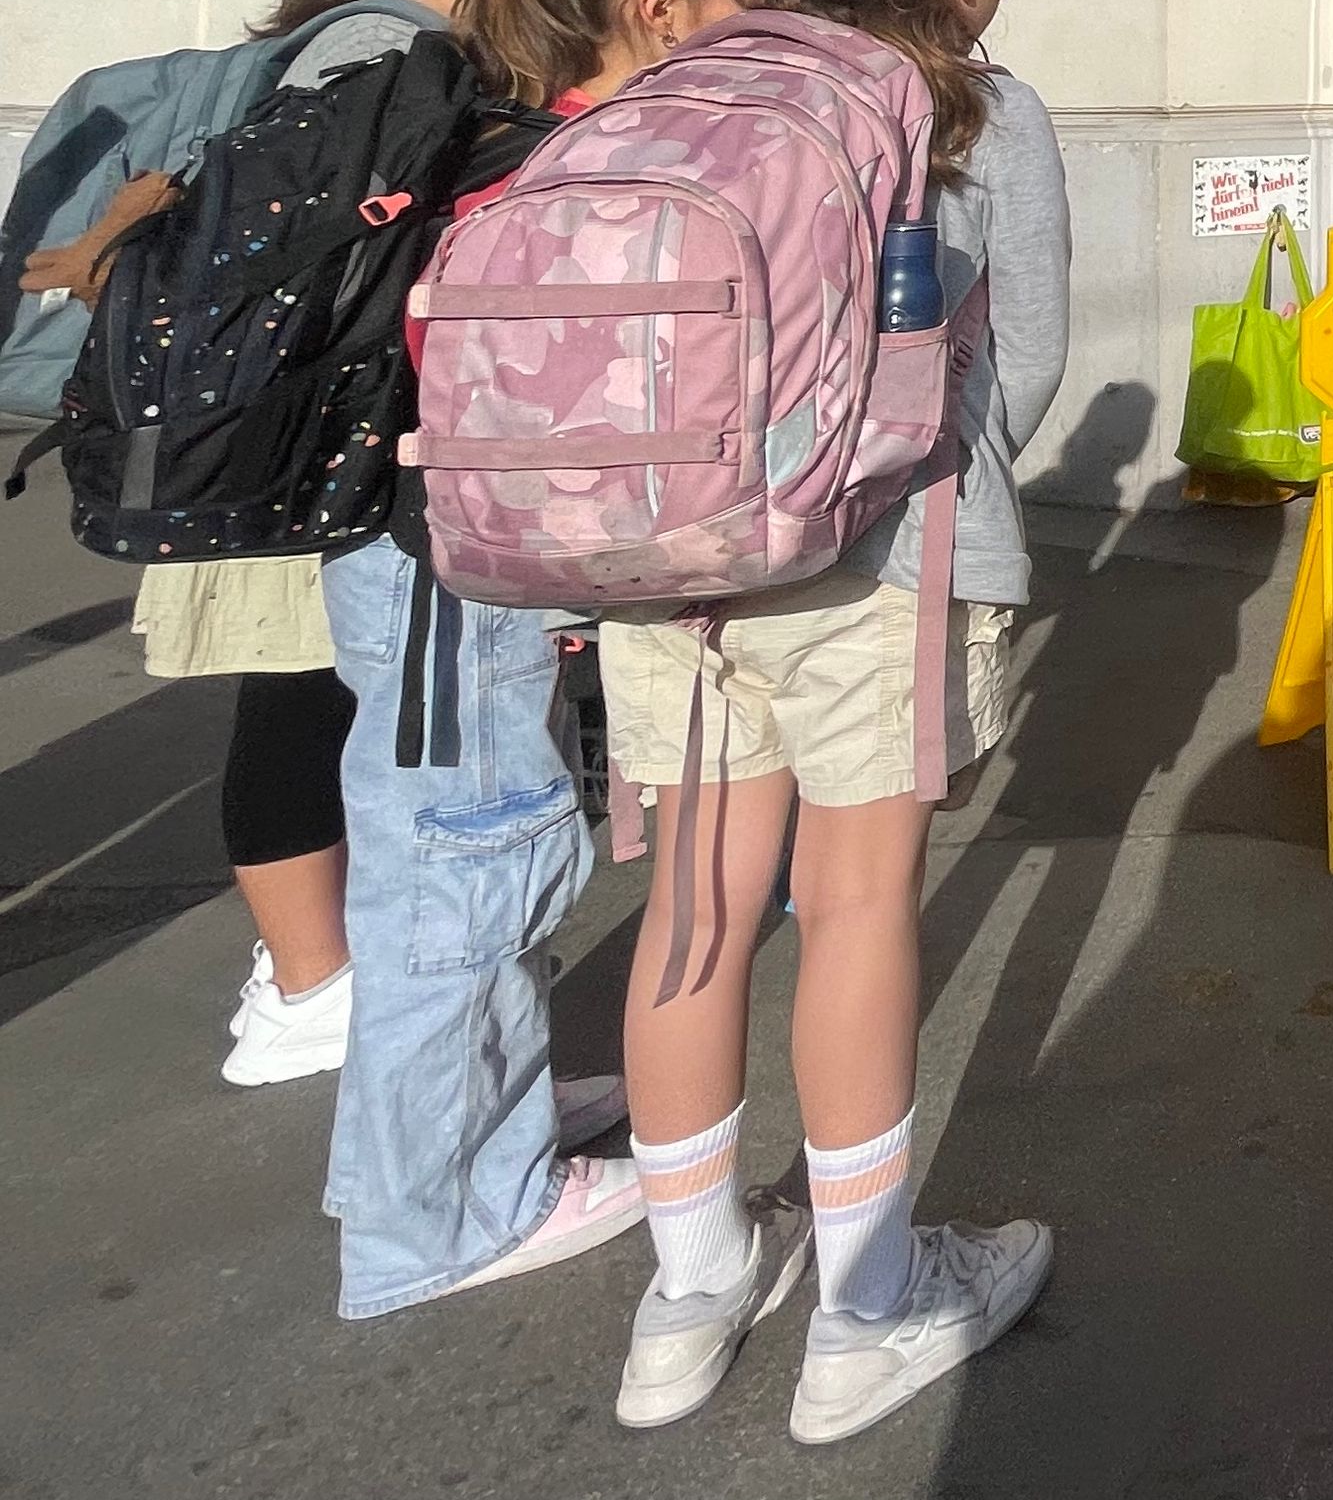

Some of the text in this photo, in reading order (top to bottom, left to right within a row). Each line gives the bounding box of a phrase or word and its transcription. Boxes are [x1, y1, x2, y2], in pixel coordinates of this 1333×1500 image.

[1210, 172, 1239, 190] Wir
[1261, 171, 1296, 194] nicht
[1210, 195, 1260, 223] hinein!
